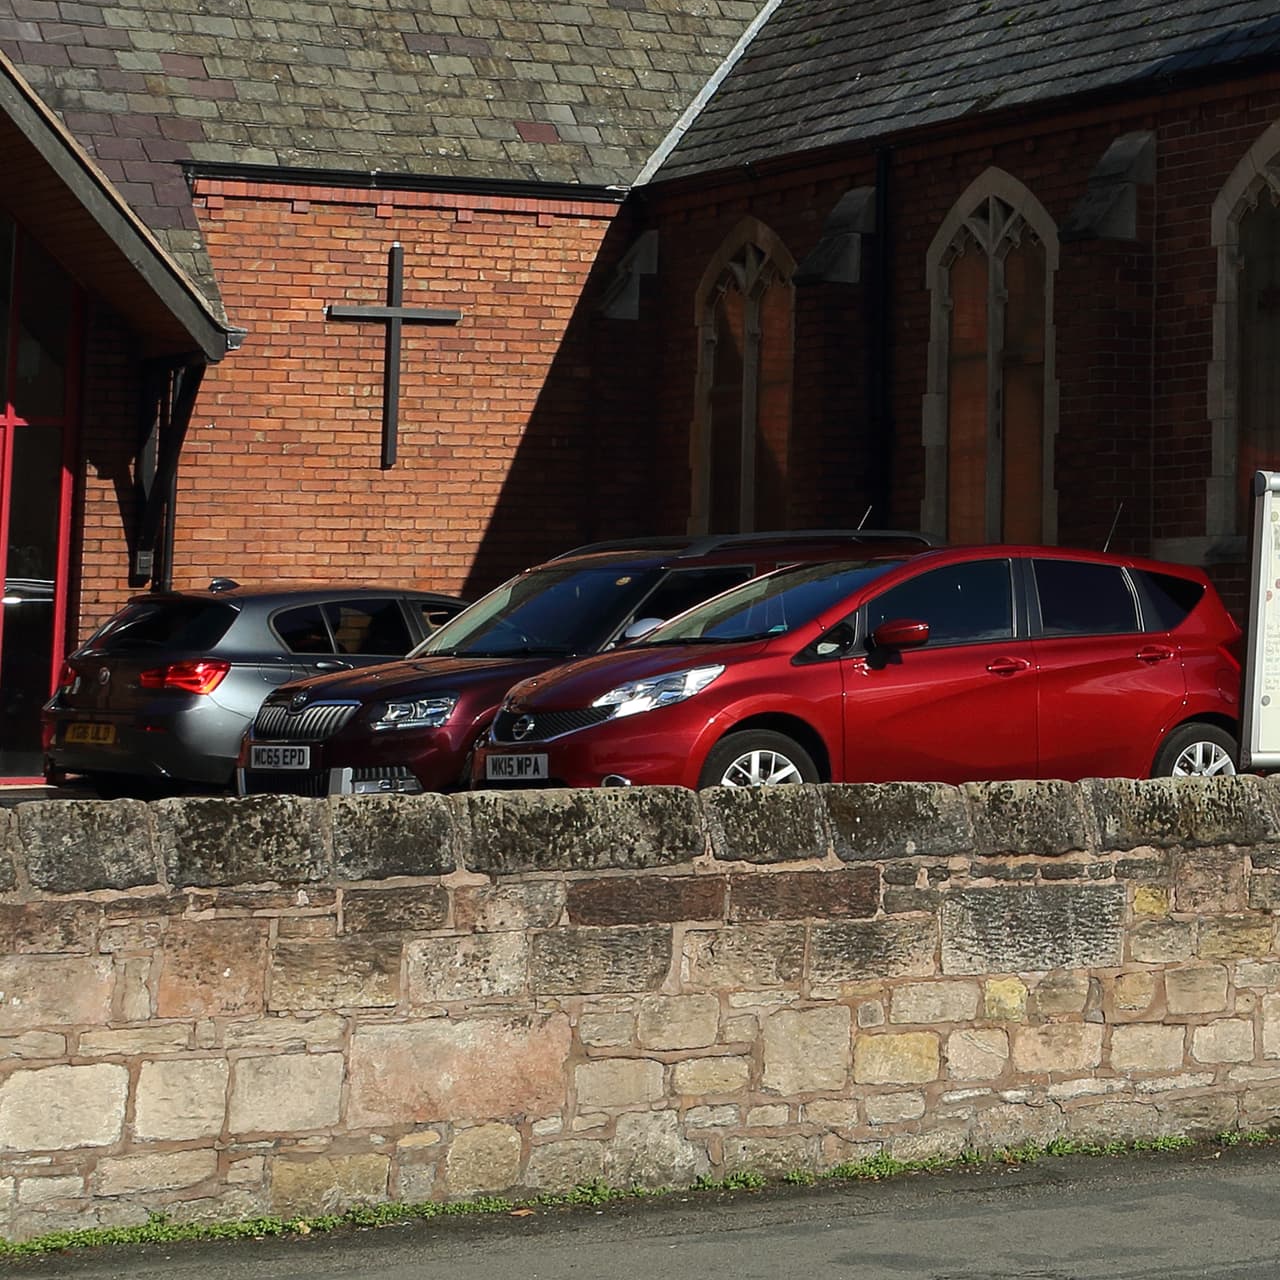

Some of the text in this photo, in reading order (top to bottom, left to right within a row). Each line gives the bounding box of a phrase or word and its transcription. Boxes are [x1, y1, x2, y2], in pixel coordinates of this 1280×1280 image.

[254, 748, 304, 765] MC65 EPD
[492, 757, 514, 776] MK15
